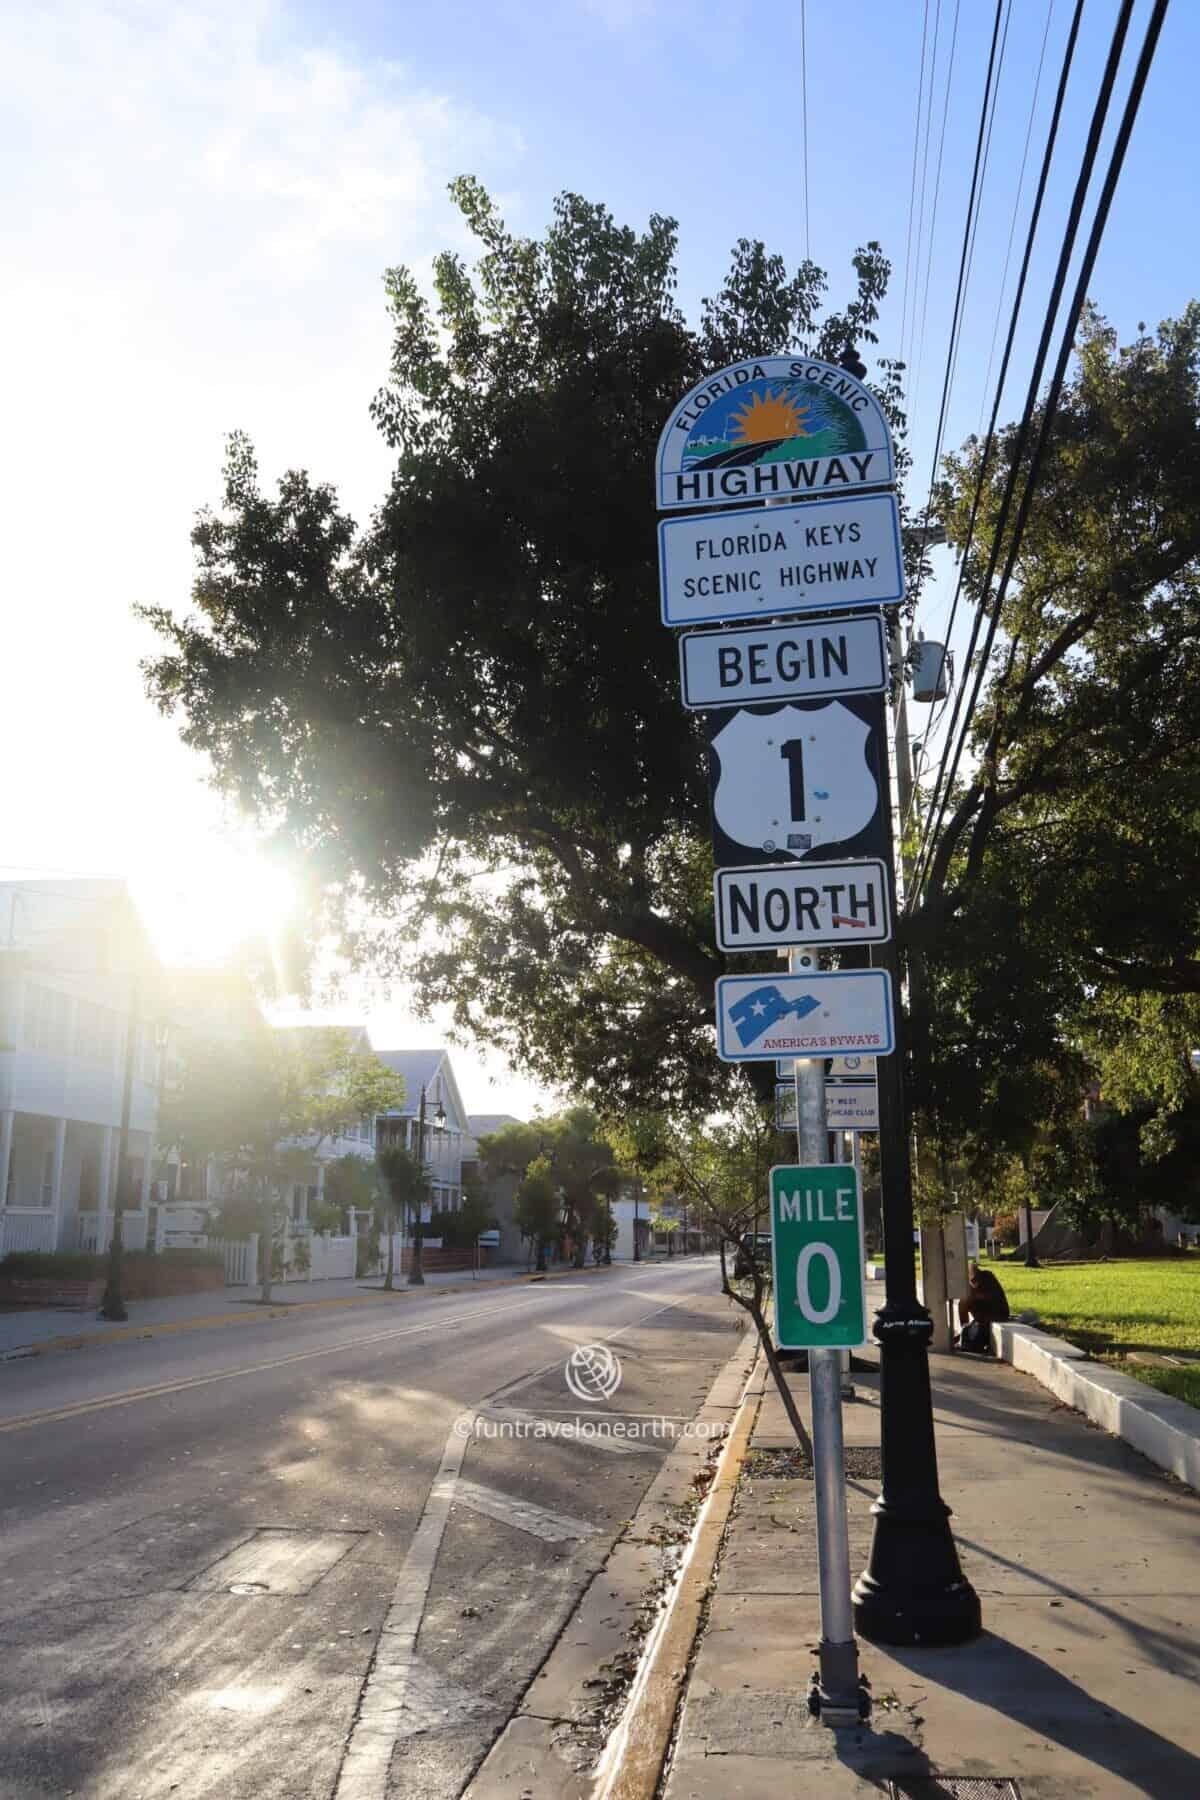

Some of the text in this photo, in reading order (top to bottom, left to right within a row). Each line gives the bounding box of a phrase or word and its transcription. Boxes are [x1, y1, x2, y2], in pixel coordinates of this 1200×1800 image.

[676, 363, 869, 433] FLORIDA SCENIC
[677, 453, 874, 500] HIGHWAY
[696, 522, 861, 560] FLORIDA KEYS
[684, 558, 878, 598] SCENIC HIGHWAY
[718, 635, 849, 688] BEGIN
[780, 738, 806, 822] 1
[729, 883, 877, 935] NORTH
[830, 1034, 880, 1047] BYWAYS
[779, 1188, 854, 1222] MILE
[796, 1241, 842, 1325] 0
